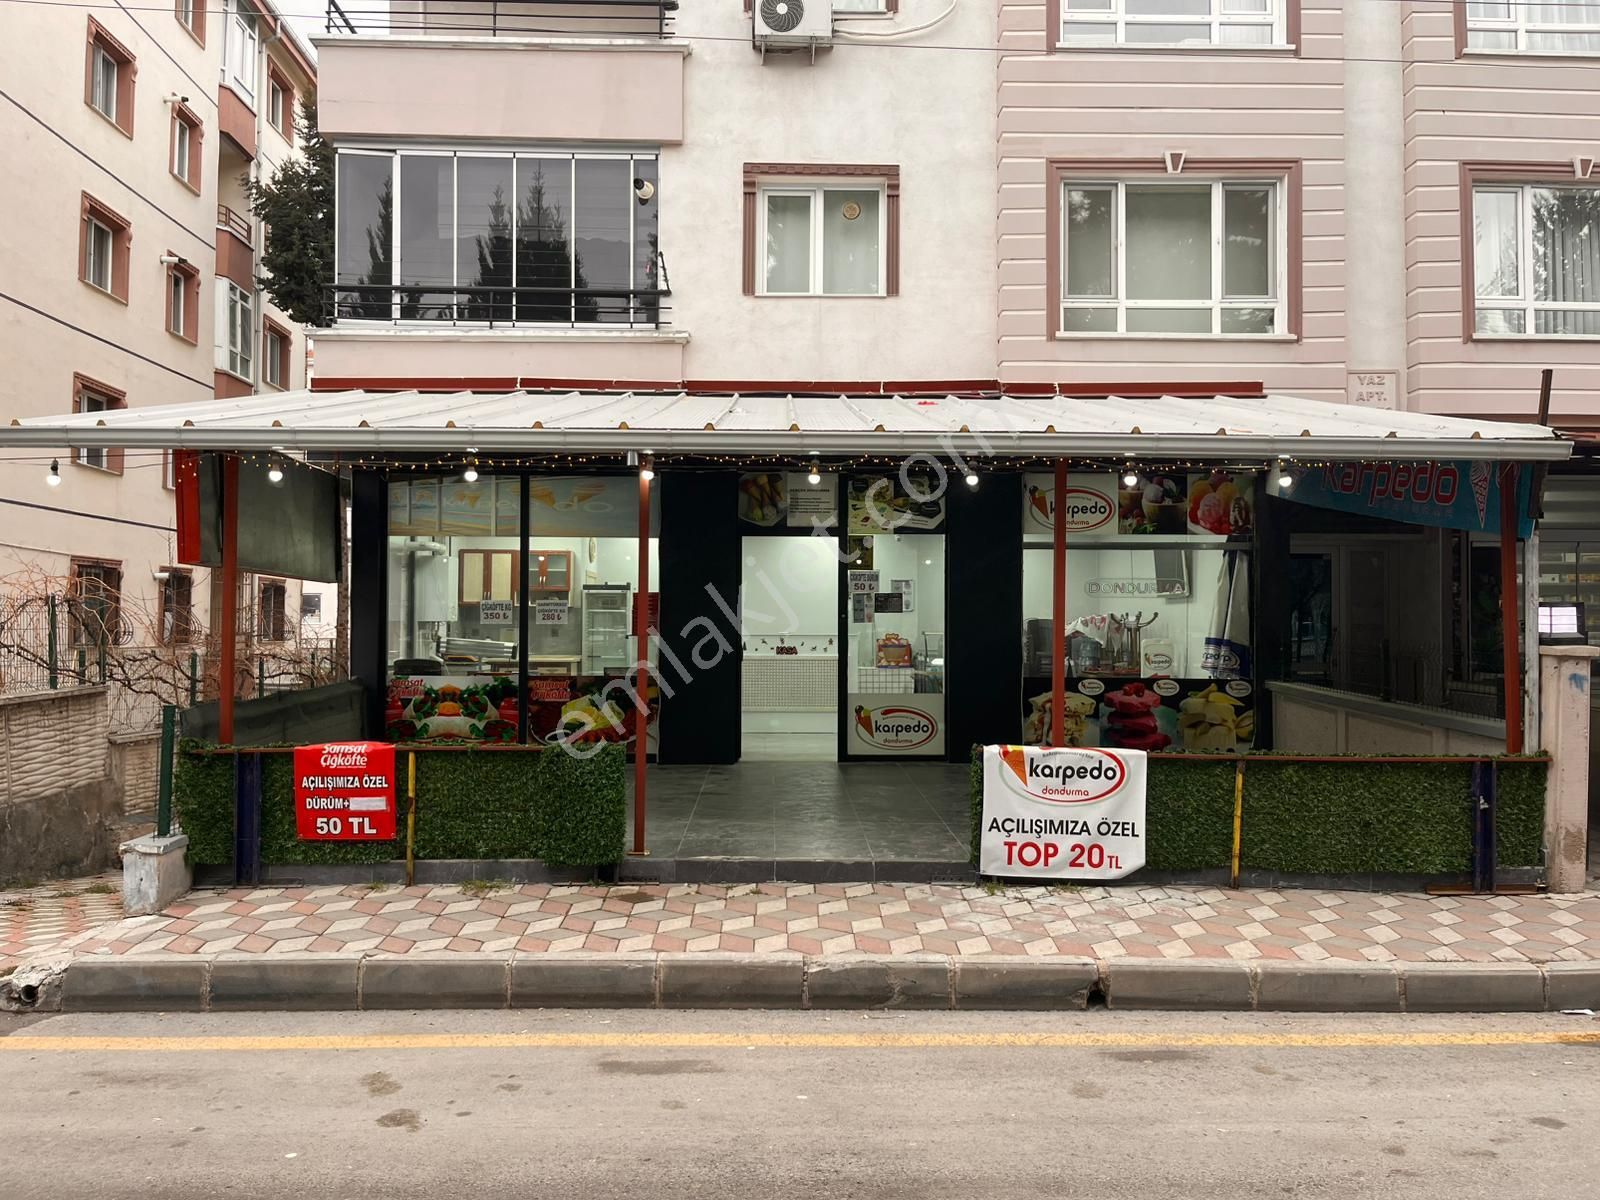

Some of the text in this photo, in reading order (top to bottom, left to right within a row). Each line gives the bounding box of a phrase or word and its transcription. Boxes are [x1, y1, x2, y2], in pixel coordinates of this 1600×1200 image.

[1357, 376, 1385, 385] YAZ
[1050, 501, 1107, 518] krpedo
[776, 646, 798, 655] KASA
[875, 720, 929, 737] karpedo
[322, 744, 367, 754] Samsat
[1029, 758, 1117, 785] karpedo
[302, 774, 389, 791] AÇILIŞIMIZA ÖZEL
[1042, 786, 1090, 797] dondurma
[316, 818, 377, 834] 50 TL
[988, 817, 1139, 838] AÇILIŞIMIZA ÖZEL
[1003, 841, 1122, 869] TOP 20 TL
